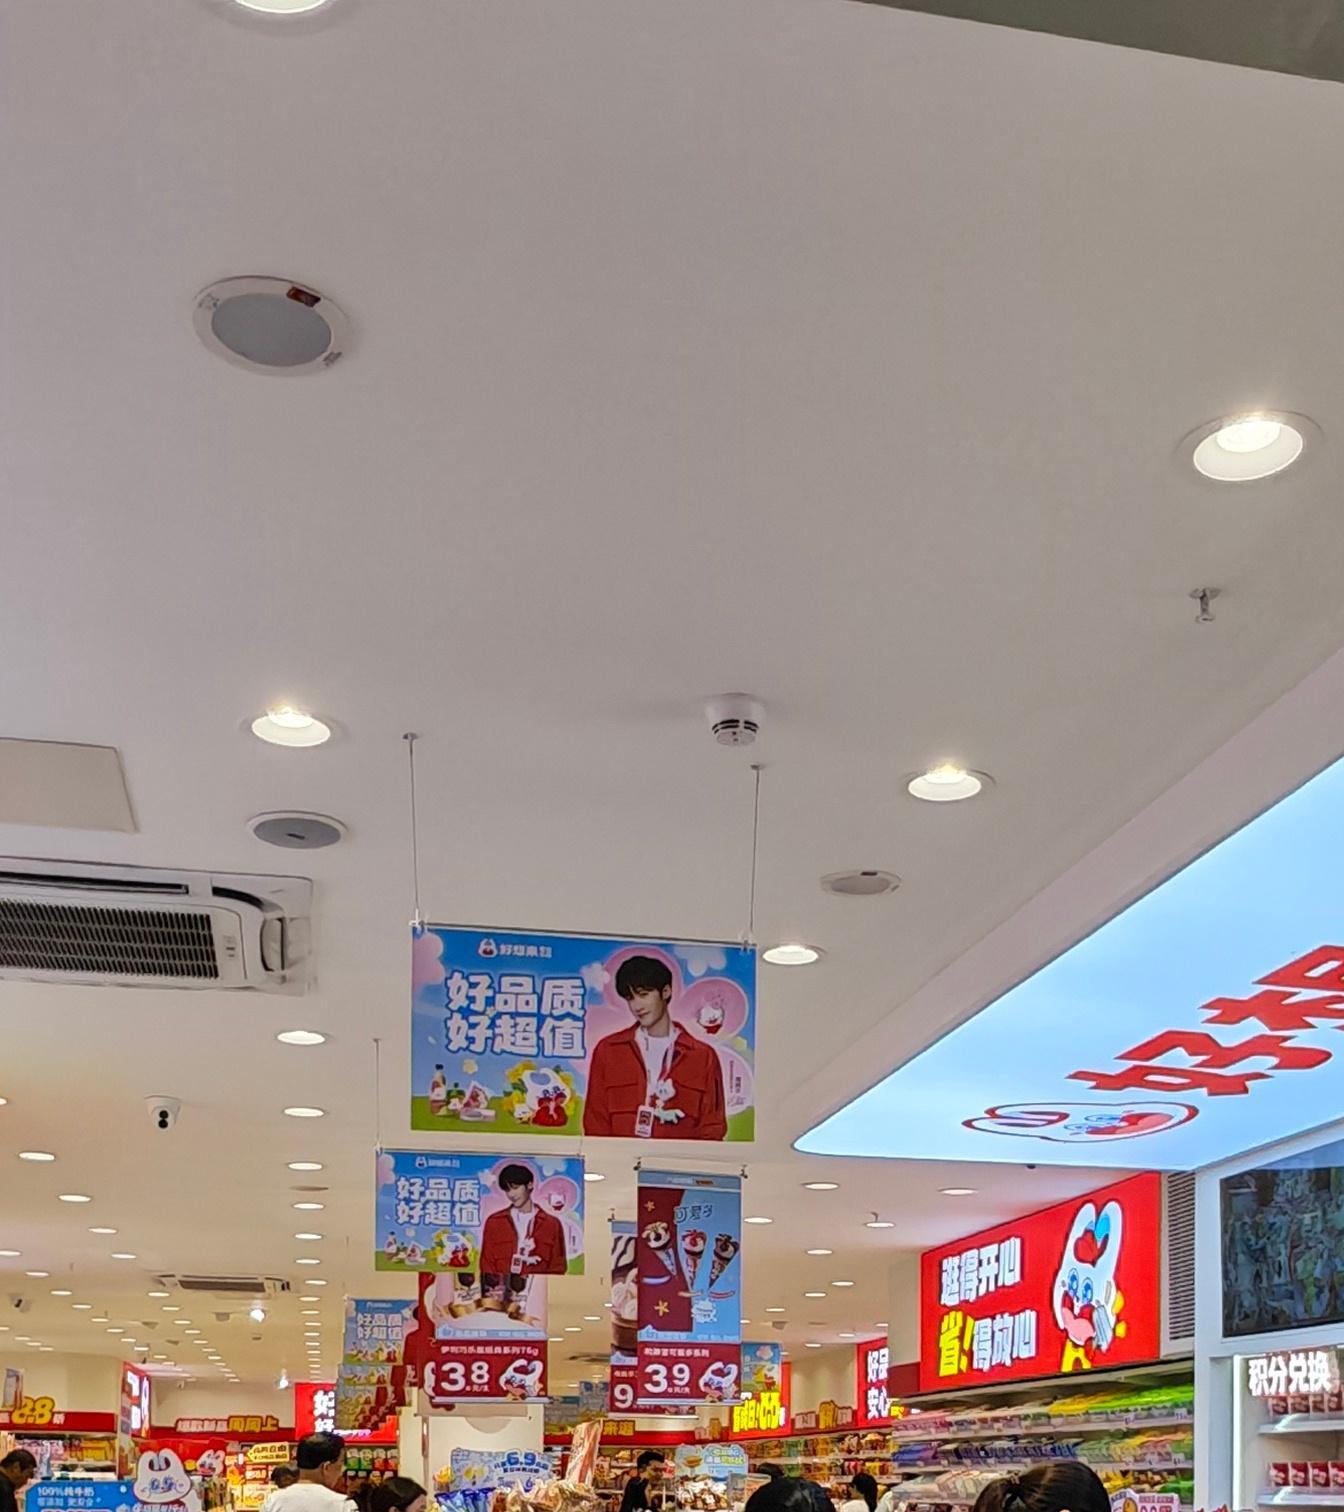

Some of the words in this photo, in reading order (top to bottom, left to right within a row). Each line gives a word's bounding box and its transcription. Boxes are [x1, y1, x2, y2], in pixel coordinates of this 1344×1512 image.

[447, 971, 585, 1018] 好品质
[447, 1011, 585, 1058] 好超值
[397, 1176, 480, 1202] 好品质
[396, 1200, 481, 1226] 好超值
[939, 1236, 1022, 1307] 逛得开心
[1248, 1351, 1332, 1397] 积分兑换
